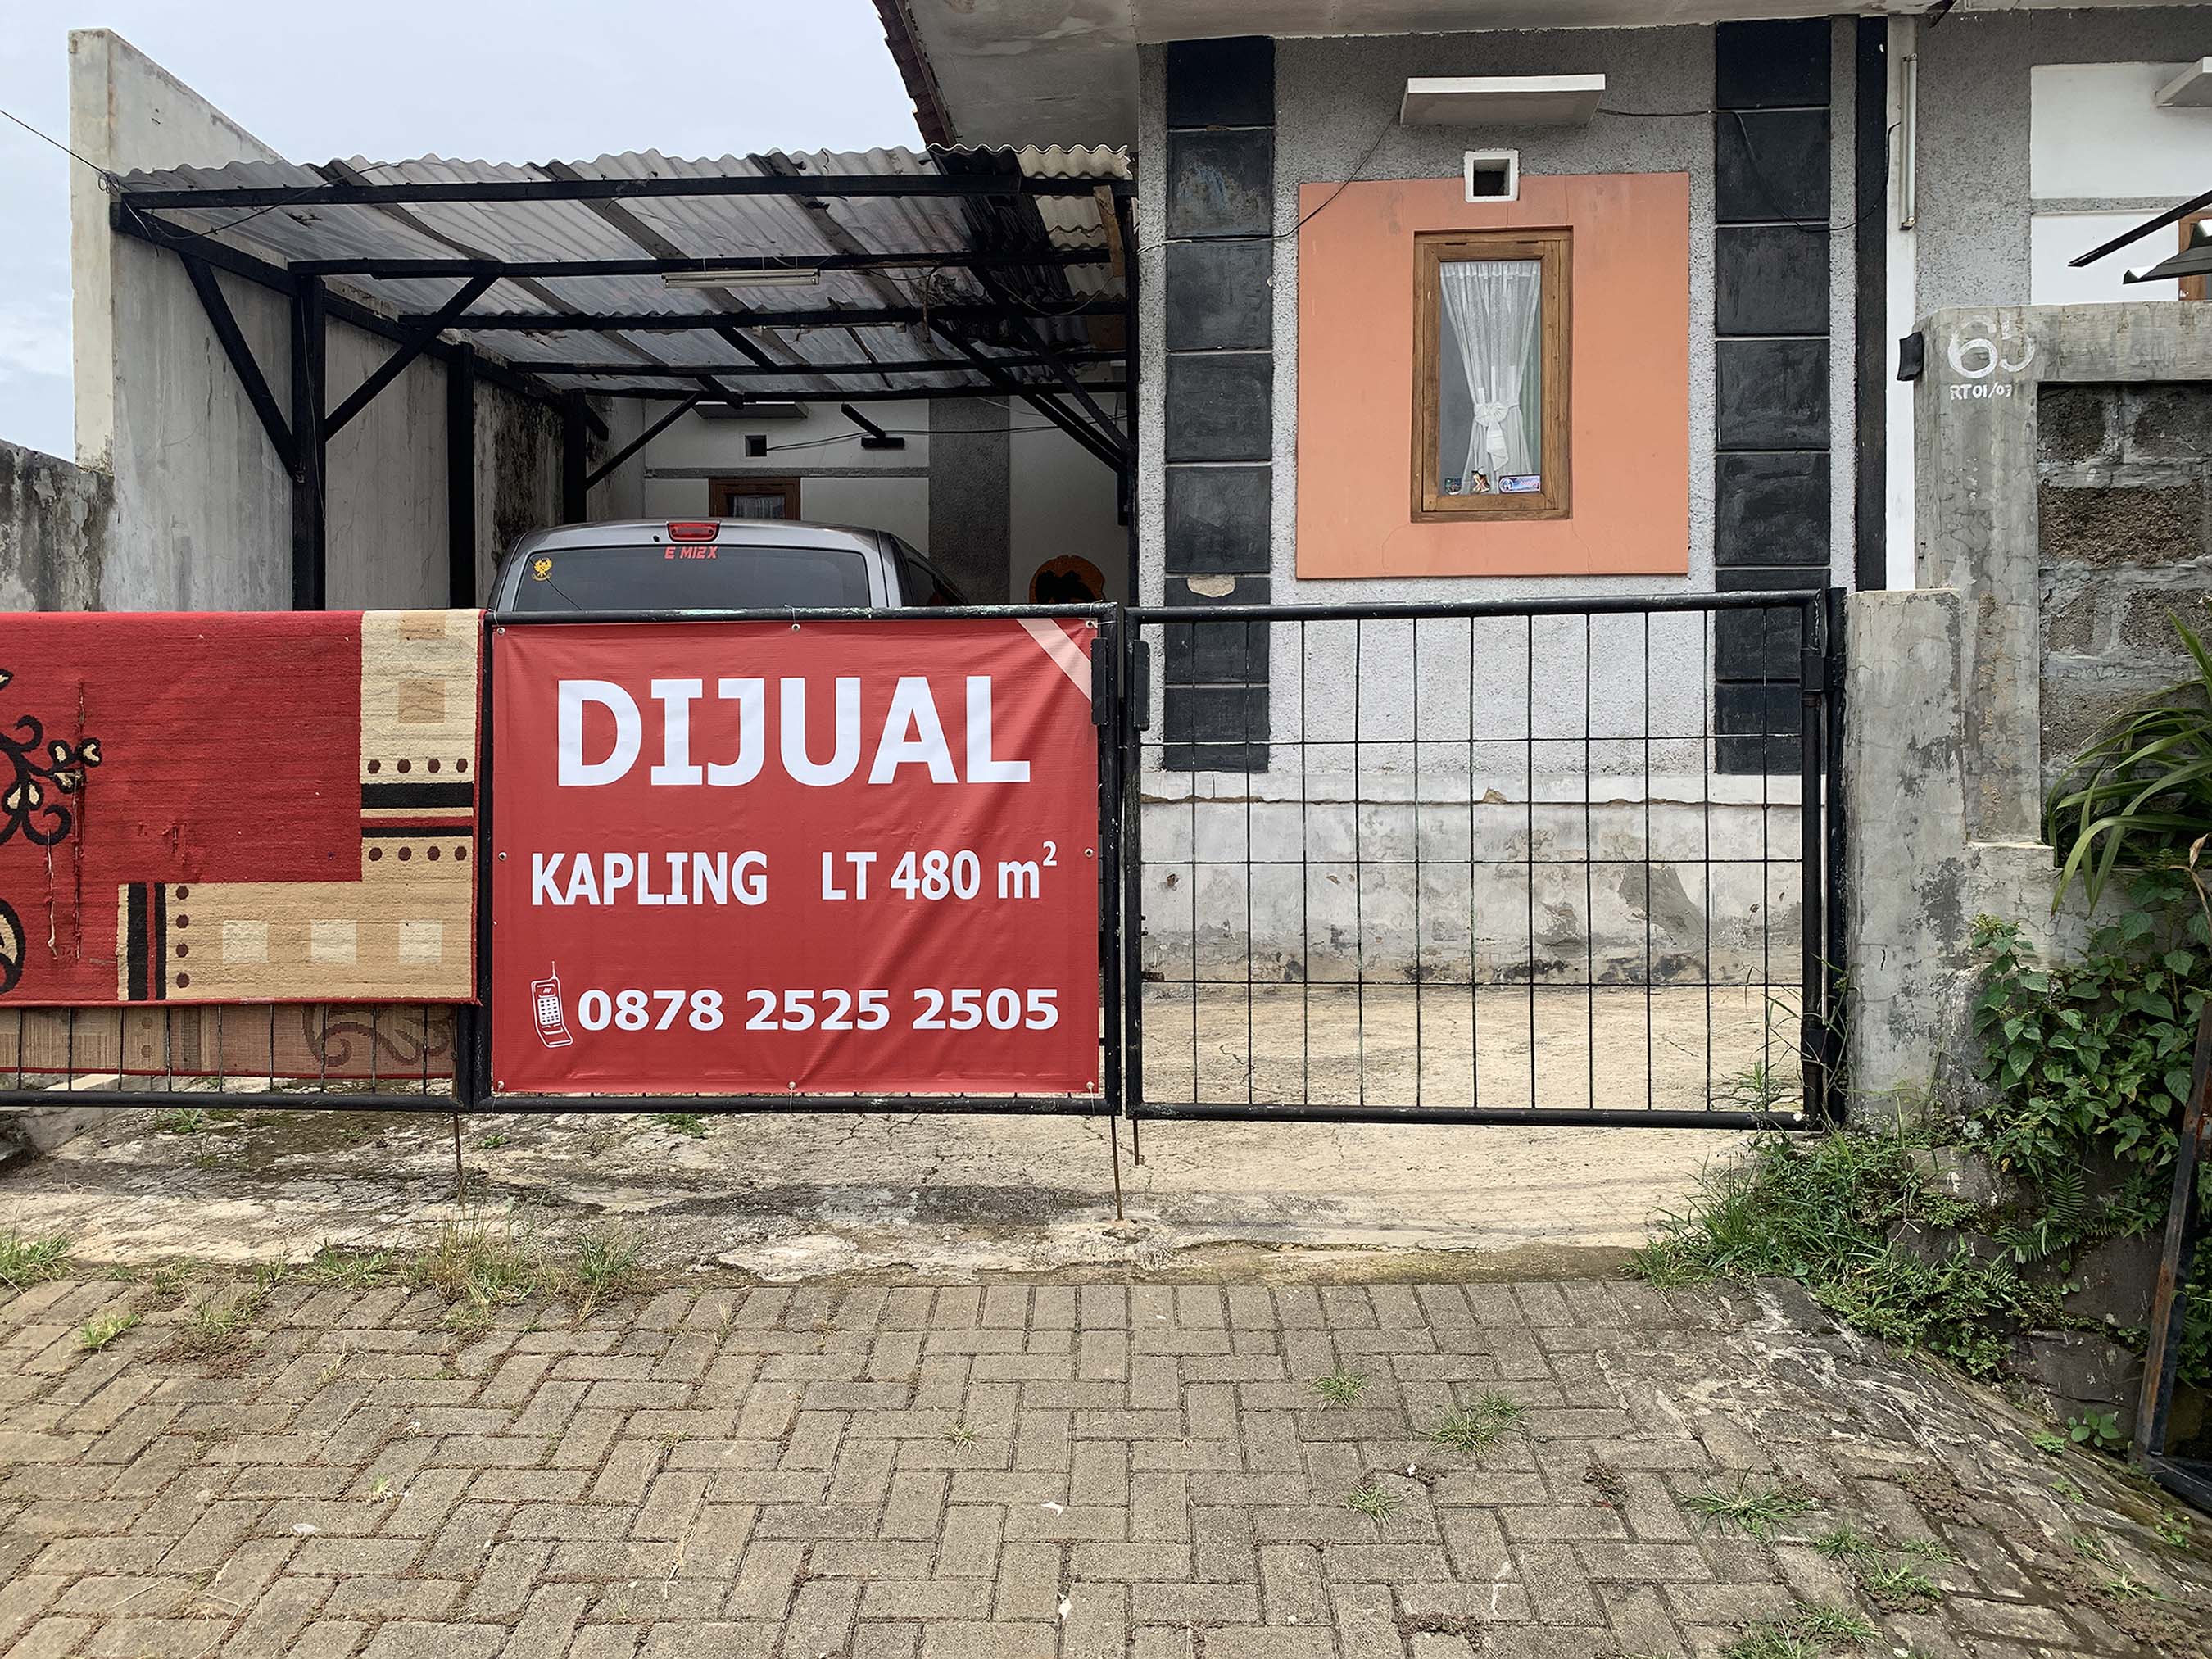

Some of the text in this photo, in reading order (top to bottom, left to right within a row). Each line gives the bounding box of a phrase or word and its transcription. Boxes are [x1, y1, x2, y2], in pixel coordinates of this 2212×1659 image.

[558, 676, 1031, 786] DIJUAL
[531, 851, 768, 905] KAPLING
[822, 852, 877, 900] LT
[890, 850, 981, 900] 480
[577, 989, 1058, 1031] 0878 2525 2505
